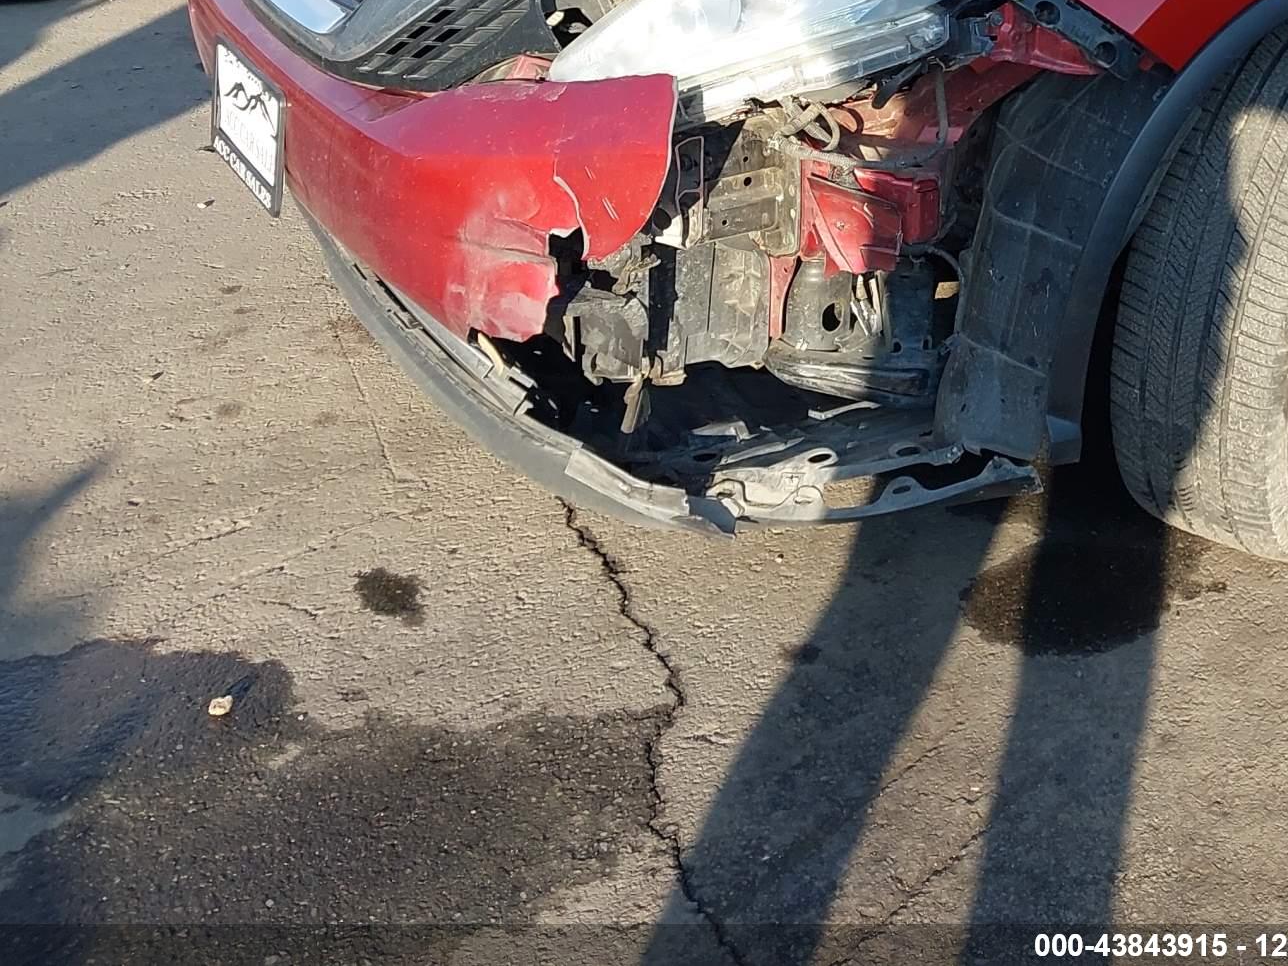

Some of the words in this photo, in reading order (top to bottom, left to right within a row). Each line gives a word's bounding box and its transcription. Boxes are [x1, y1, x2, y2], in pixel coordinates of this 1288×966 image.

[213, 135, 230, 161] ACC
[229, 150, 246, 181] CAR
[245, 169, 273, 210] SALES
